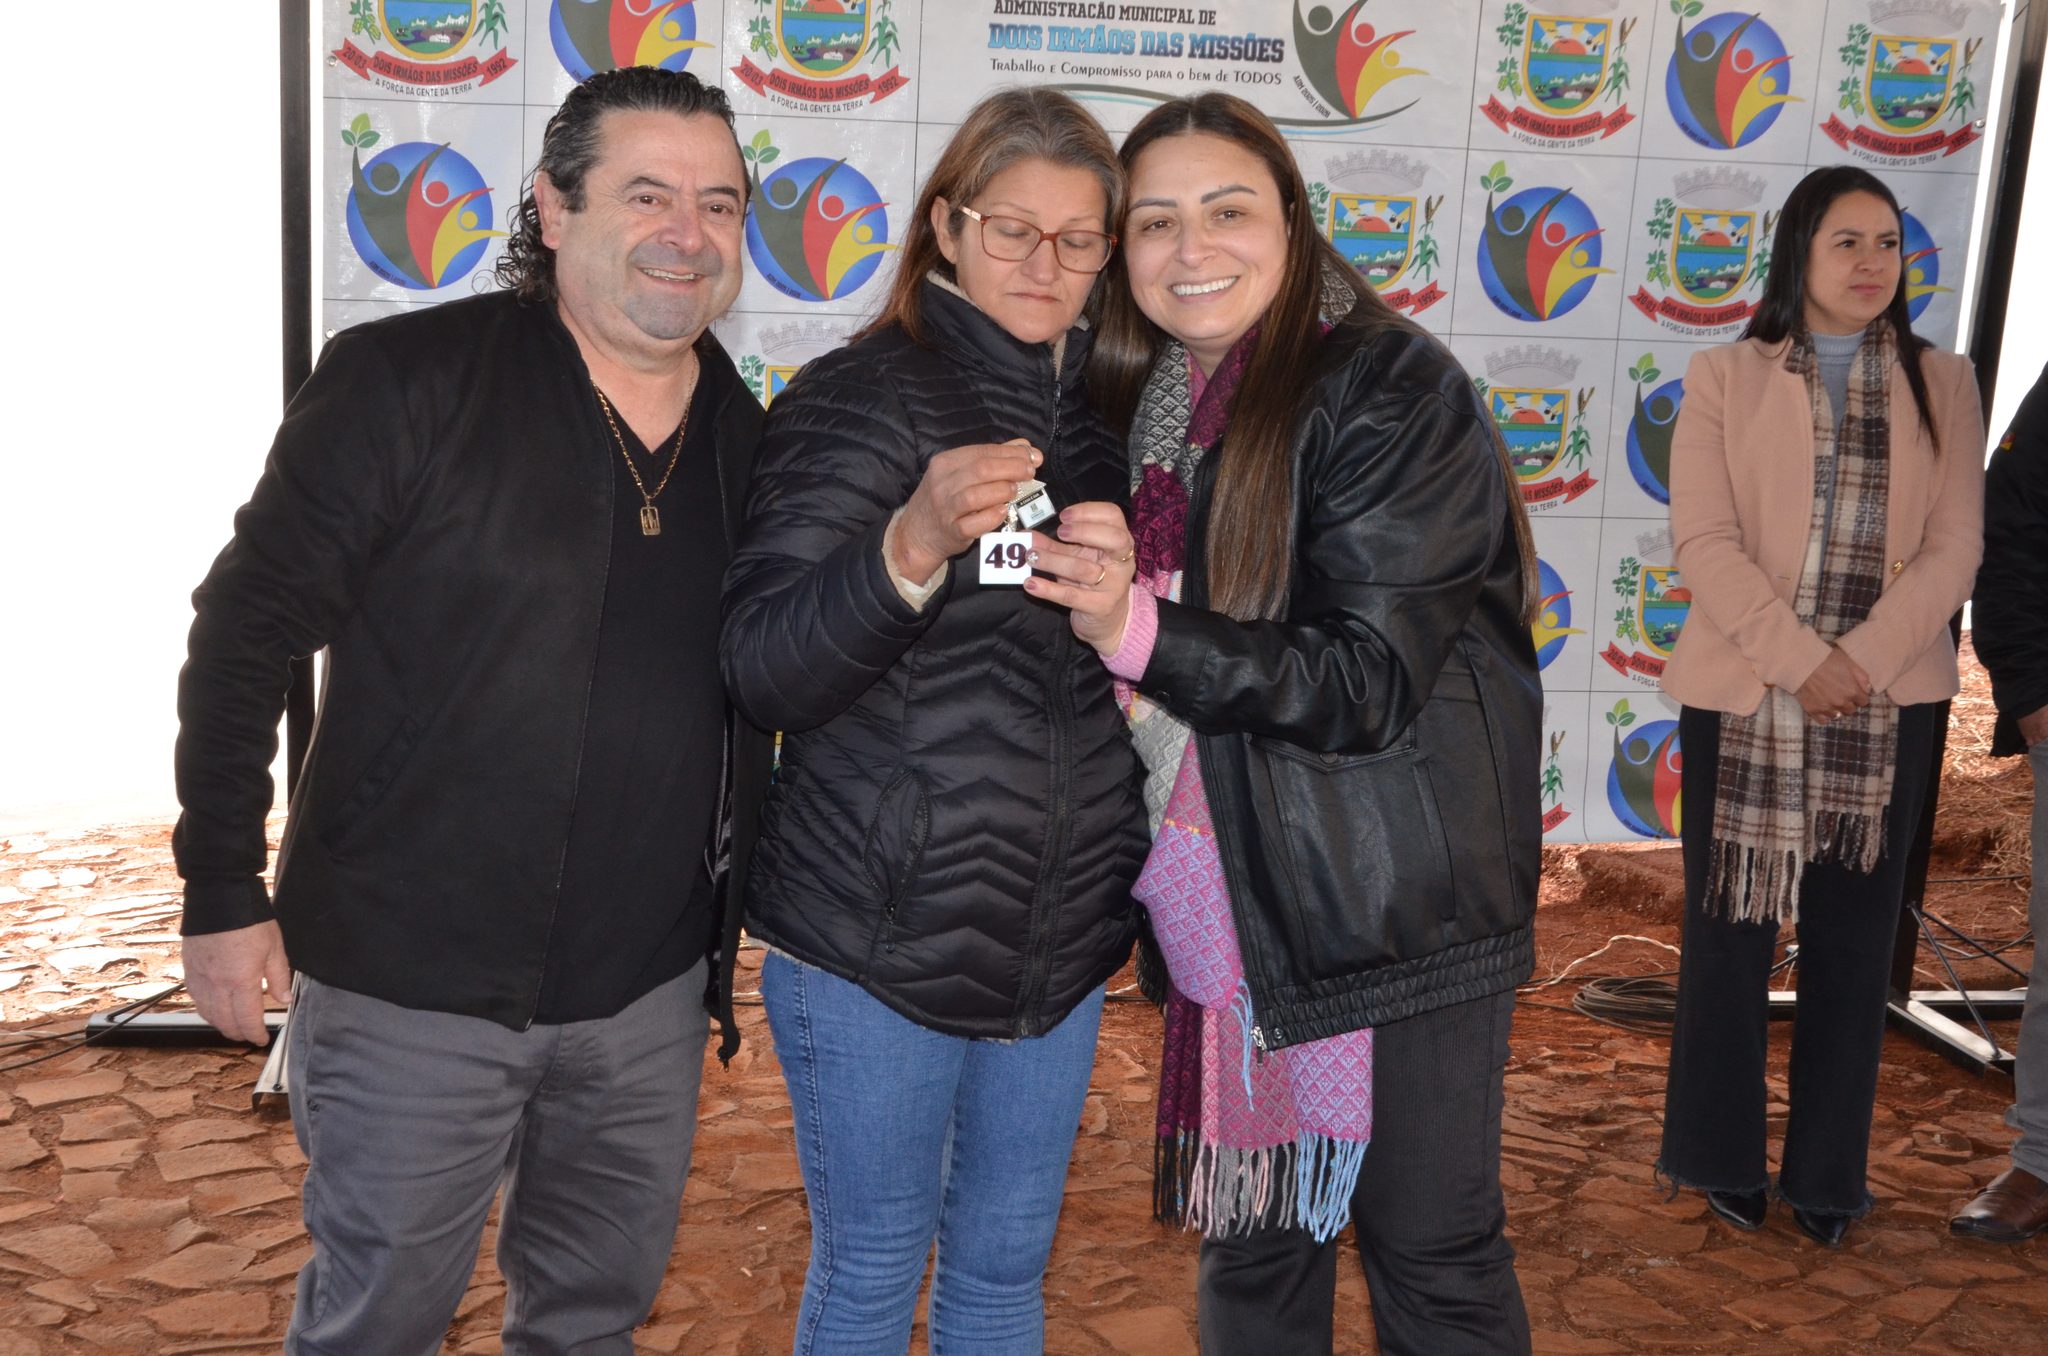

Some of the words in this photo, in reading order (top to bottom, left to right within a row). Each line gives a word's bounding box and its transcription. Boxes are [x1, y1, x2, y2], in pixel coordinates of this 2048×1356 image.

[1119, 5, 1194, 25] MUNICIPAL
[1198, 10, 1217, 25] DE
[988, 23, 1043, 50] DOIS
[1047, 24, 1136, 55] IRMÃOS
[1139, 30, 1184, 57] DAS
[1188, 32, 1285, 63] MISSÕES
[373, 55, 391, 74] DOIS
[426, 70, 441, 82] DAS
[487, 58, 507, 77] 1992
[769, 73, 786, 90] DOIS
[819, 87, 834, 99] DAS
[878, 76, 899, 94] 1992
[1234, 70, 1282, 85] TODOS
[416, 87, 439, 96] GENTE
[451, 82, 472, 95] TERRA
[810, 104, 830, 113] GENTE
[843, 100, 864, 111] TERRA
[985, 543, 1027, 569] 49
